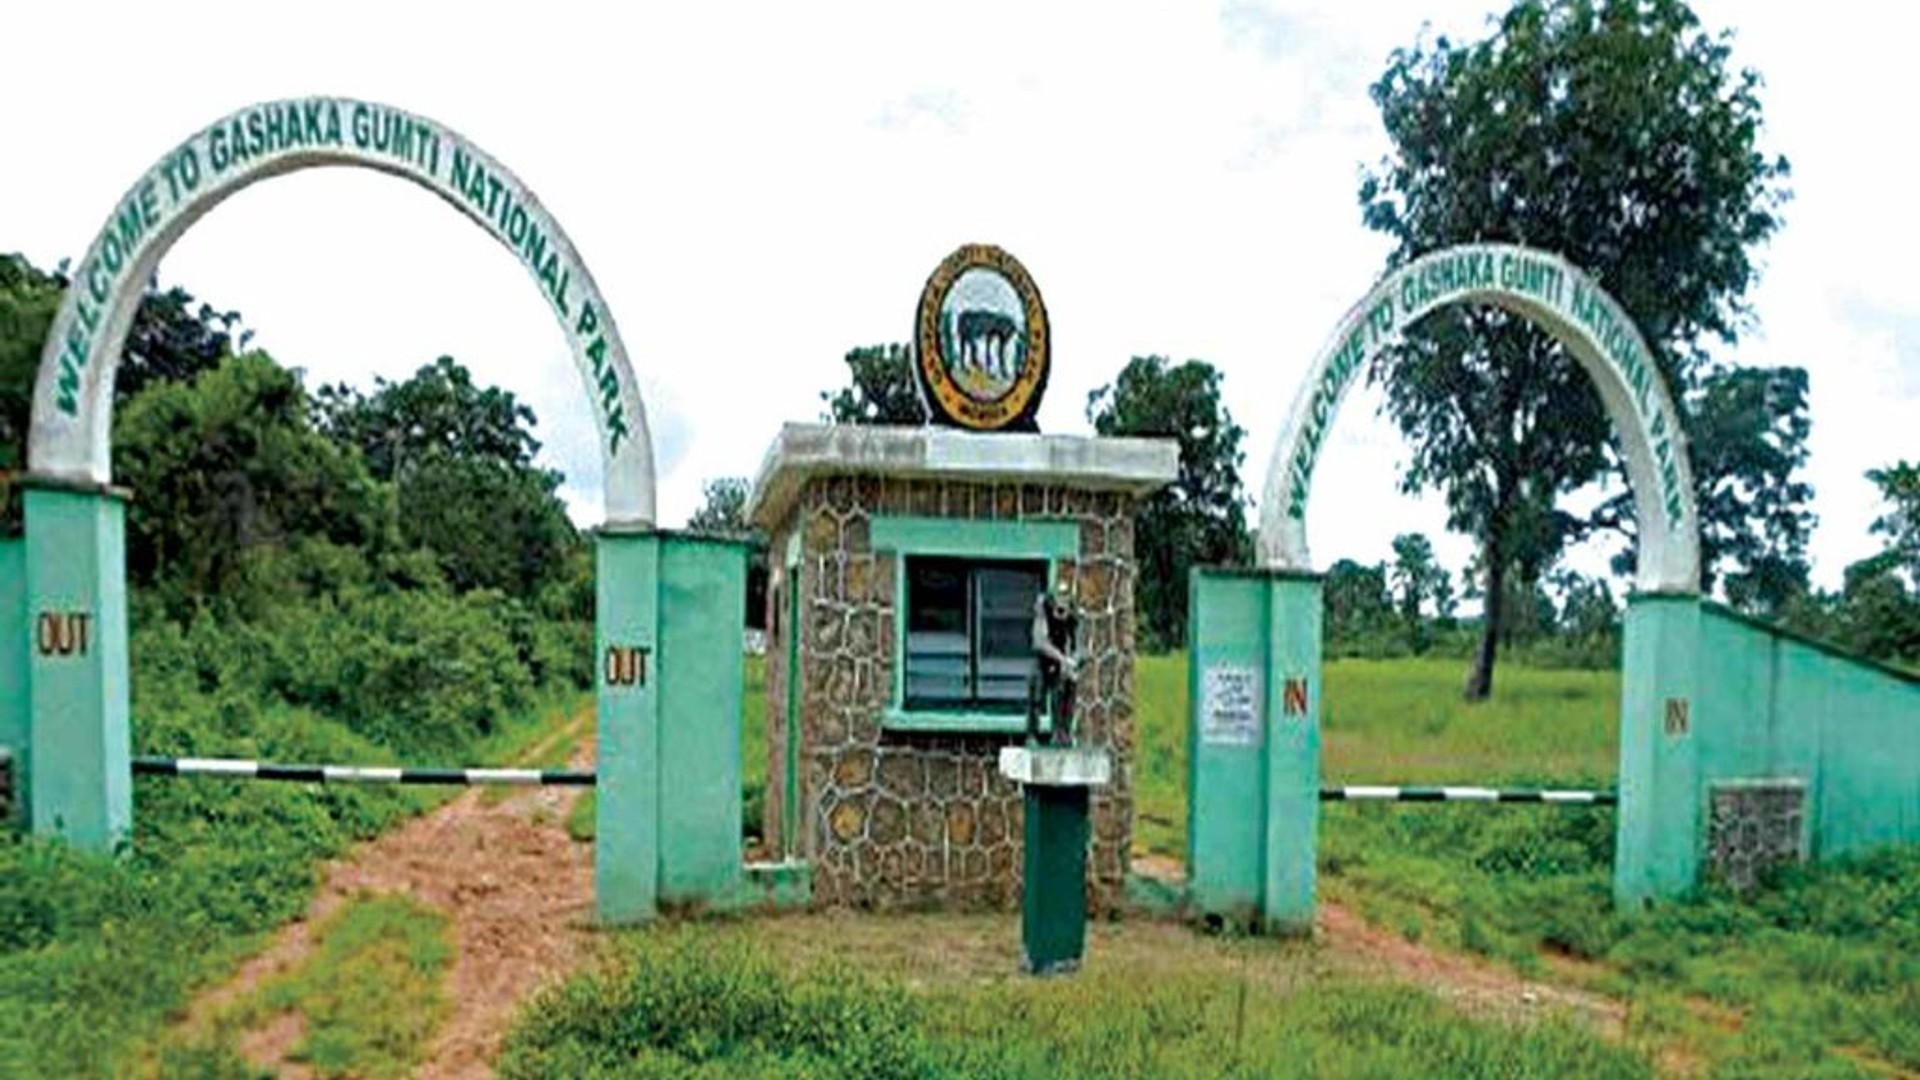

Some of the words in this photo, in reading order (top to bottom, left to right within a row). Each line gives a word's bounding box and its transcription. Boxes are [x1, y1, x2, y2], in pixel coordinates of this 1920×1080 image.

[58, 180, 161, 417] WELCOME
[162, 147, 199, 201] TO
[209, 101, 342, 174] GASHAKA
[353, 102, 440, 176] GUMTI
[451, 150, 569, 317] NATIONAL
[577, 300, 627, 457] PARK
[1287, 326, 1365, 520] WELCOME
[1367, 301, 1394, 344] TO
[1402, 253, 1494, 313] GASHAKA
[1502, 253, 1564, 305] GUMTI
[1572, 283, 1651, 417] NATIONAL
[1652, 408, 1682, 530] PARK
[37, 612, 93, 657] OUT
[604, 645, 651, 688] OUT
[1283, 678, 1307, 717] IN
[1665, 697, 1689, 734] IN
